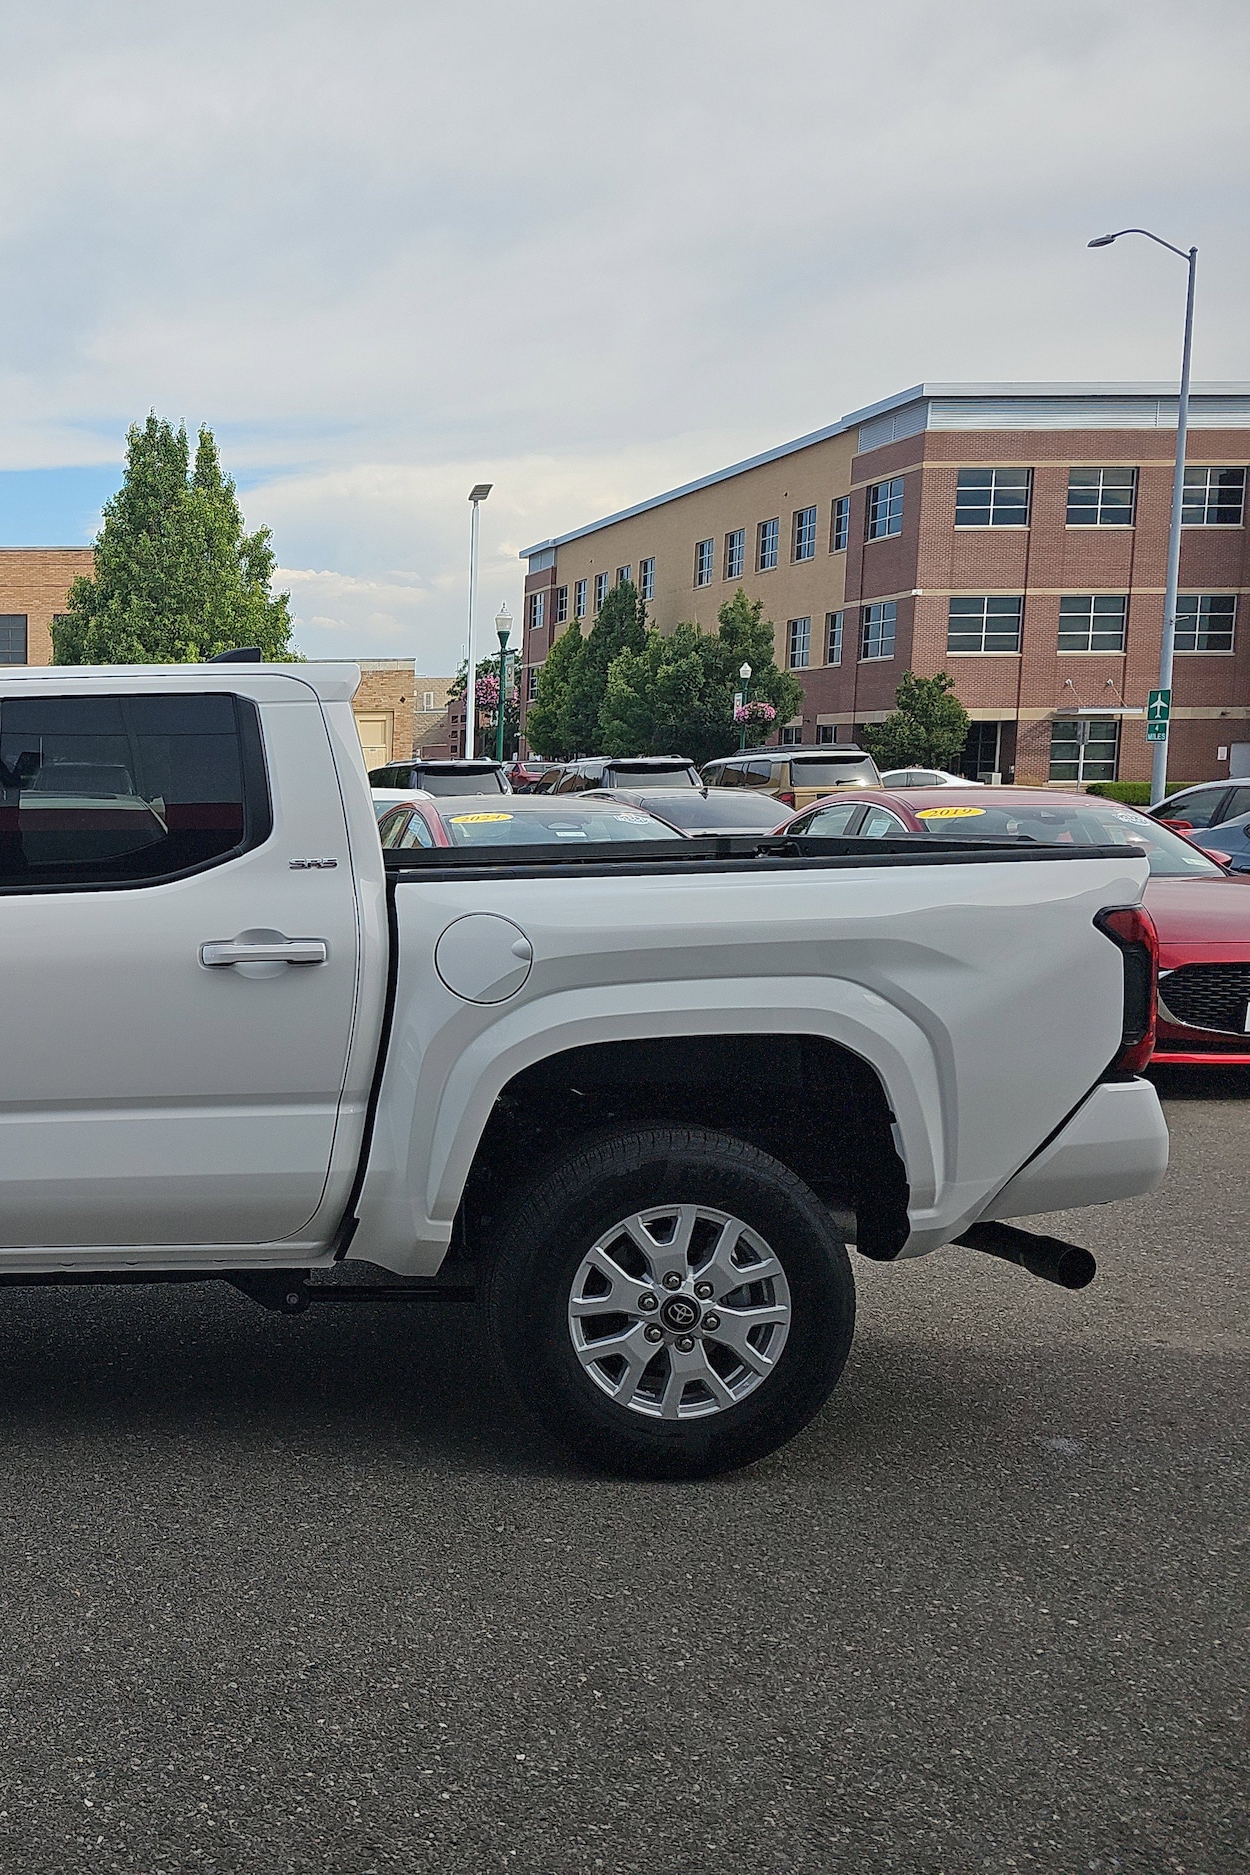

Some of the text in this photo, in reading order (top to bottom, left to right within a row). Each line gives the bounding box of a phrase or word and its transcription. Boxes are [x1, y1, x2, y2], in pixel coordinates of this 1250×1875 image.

[1154, 723, 1159, 731] 4
[1147, 732, 1166, 741] MILES
[928, 808, 972, 817] 2019
